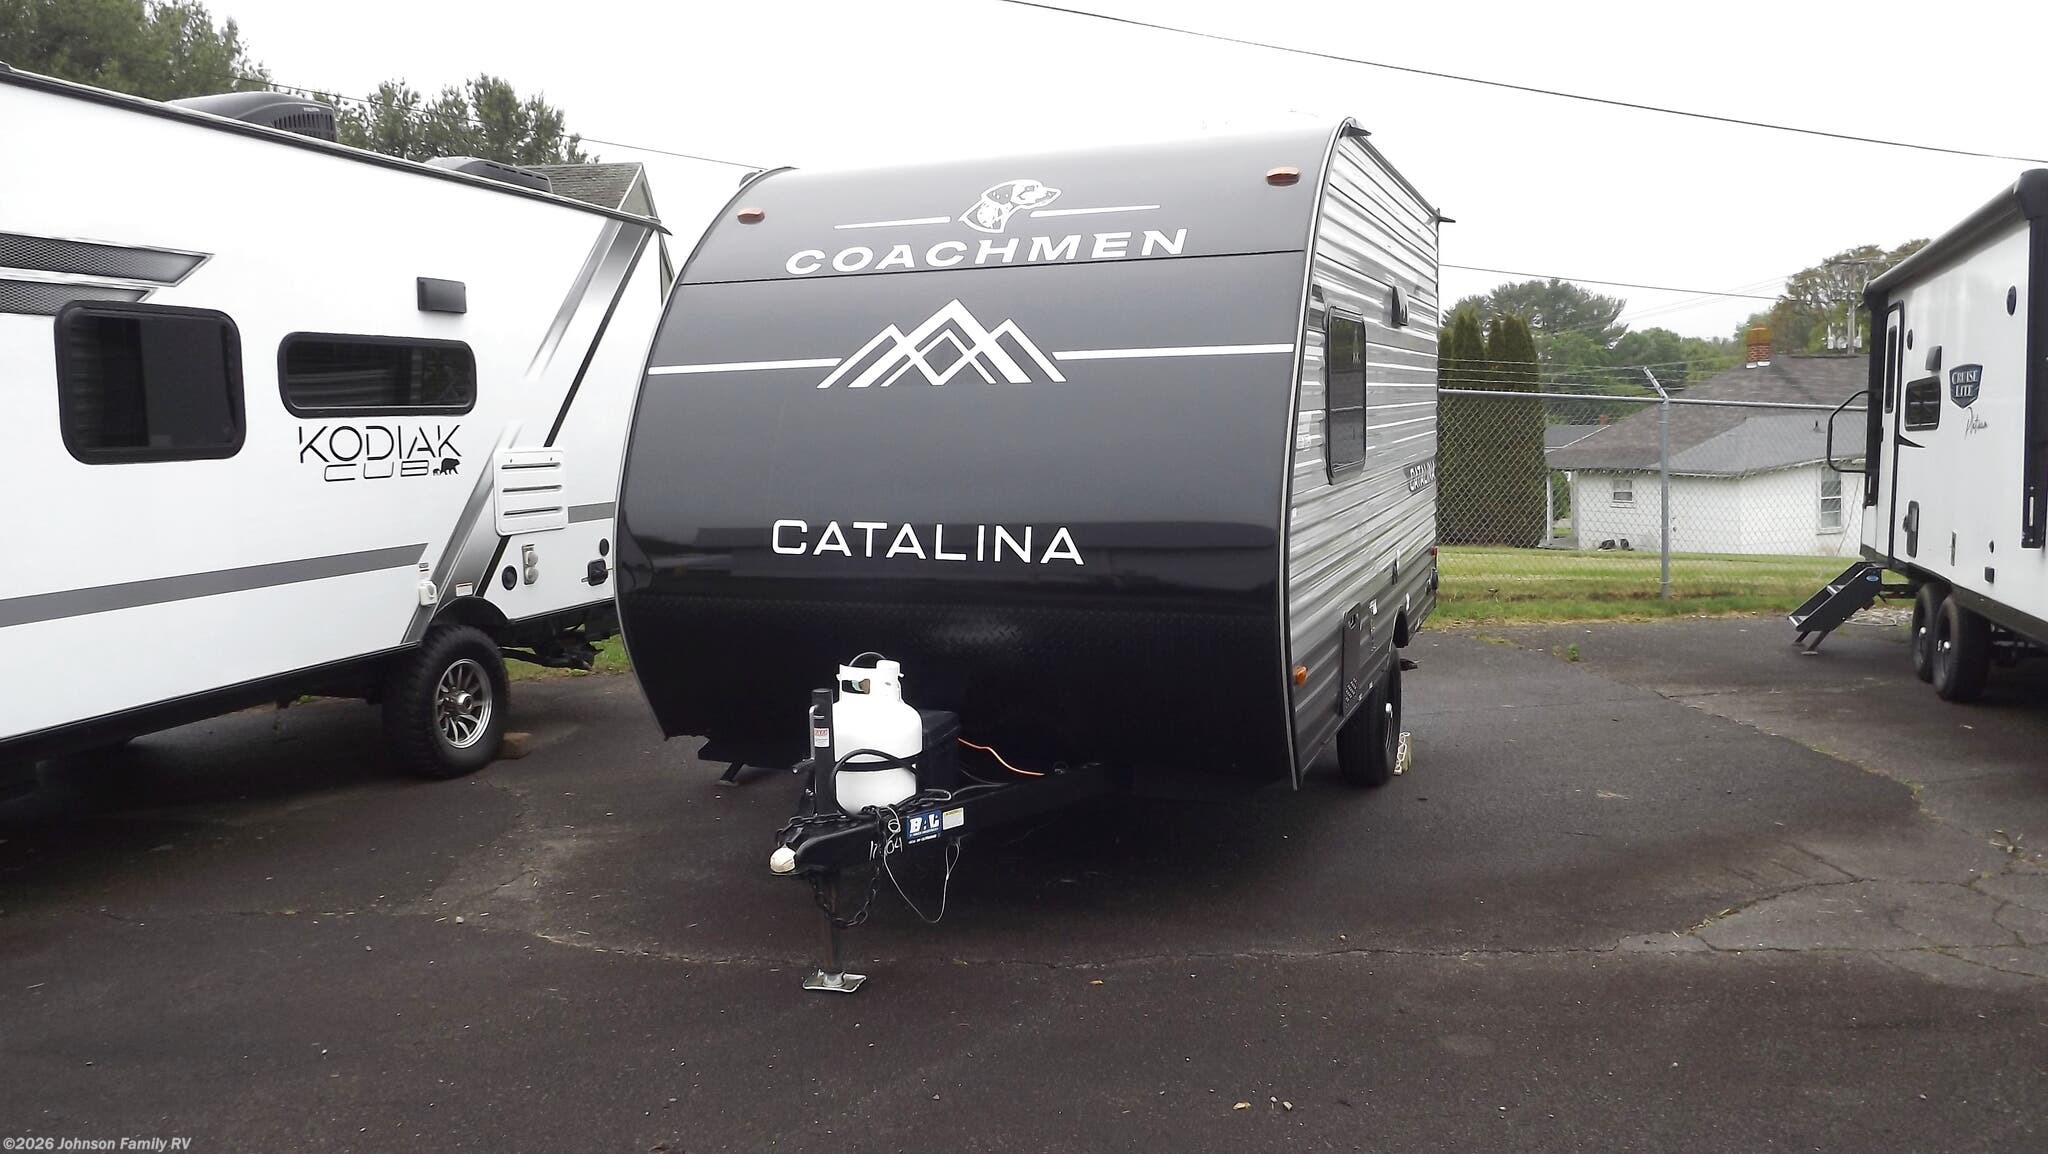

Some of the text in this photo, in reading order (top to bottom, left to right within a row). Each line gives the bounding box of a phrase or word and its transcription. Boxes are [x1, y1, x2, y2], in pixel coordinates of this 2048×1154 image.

[785, 228, 1188, 276] COACHMEN
[1955, 385, 1973, 398] LITE
[298, 424, 462, 464] KODIAK
[324, 460, 430, 483] CUB
[771, 518, 1086, 566] CATALINA
